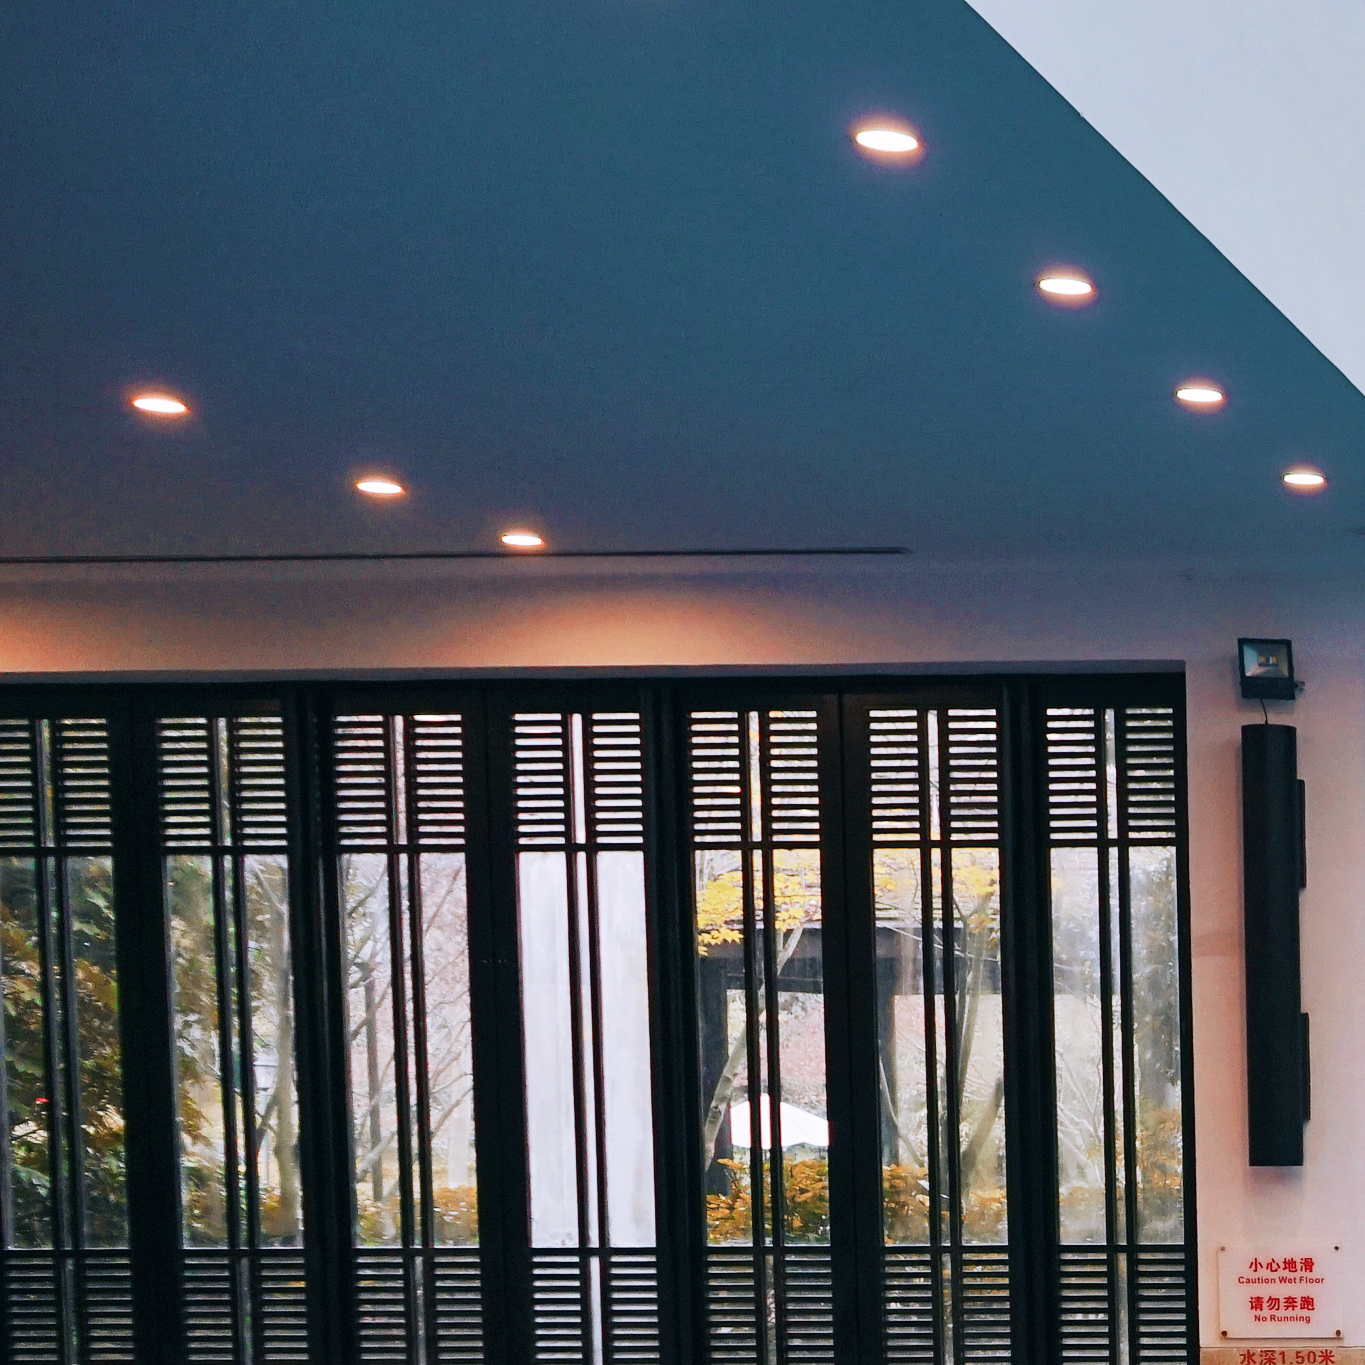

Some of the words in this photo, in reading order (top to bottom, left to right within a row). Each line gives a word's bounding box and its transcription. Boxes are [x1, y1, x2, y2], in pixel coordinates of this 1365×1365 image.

[1249, 1258, 1314, 1272] 小心地滑
[1238, 1276, 1276, 1284] Caution
[1279, 1276, 1297, 1284] Wet
[1299, 1276, 1325, 1284] Floor
[1249, 1296, 1315, 1311] 请勿奔跑
[1254, 1314, 1267, 1322] No
[1270, 1314, 1311, 1324] Running
[1239, 1349, 1335, 1365] 水深1.50米
